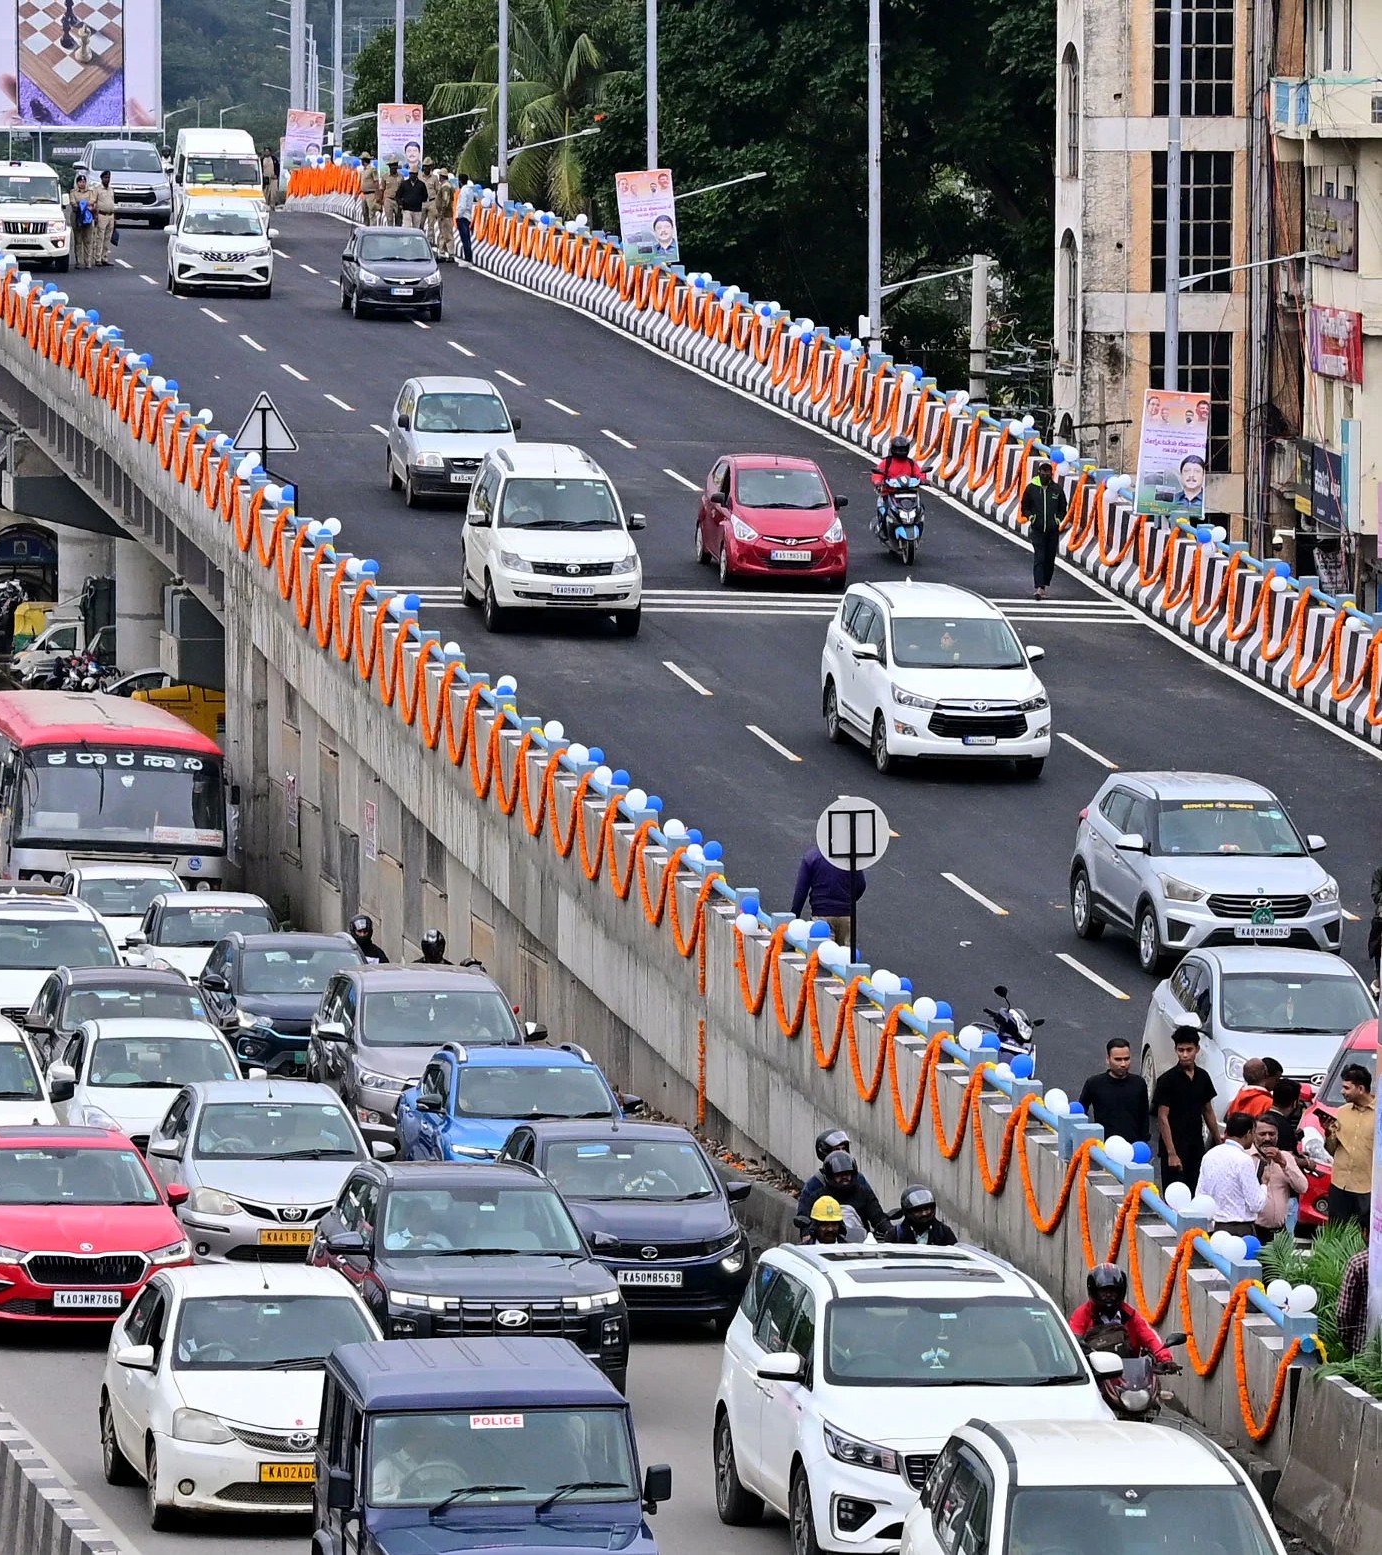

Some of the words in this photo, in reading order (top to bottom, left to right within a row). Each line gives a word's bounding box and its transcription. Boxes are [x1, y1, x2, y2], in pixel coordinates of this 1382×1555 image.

[622, 1271, 682, 1284] KA50MB5638
[60, 1294, 120, 1304] KA03MR7866
[472, 1415, 522, 1428] POLICE
